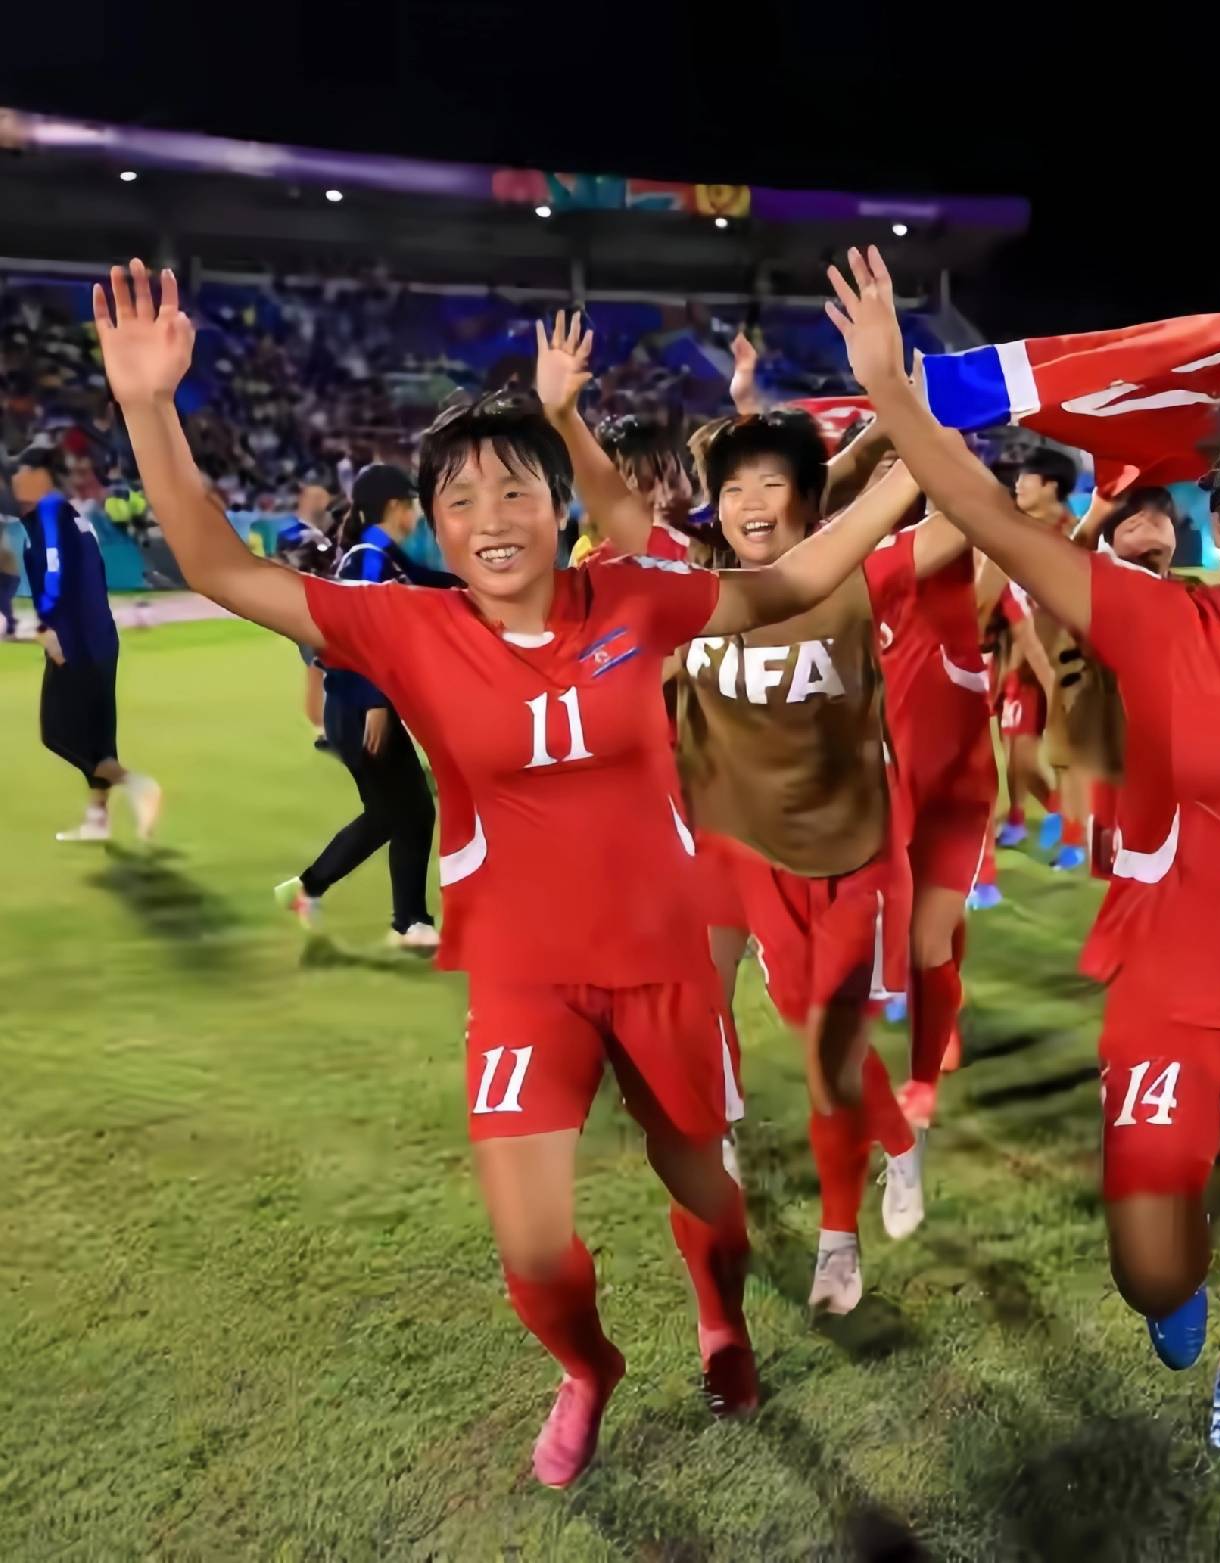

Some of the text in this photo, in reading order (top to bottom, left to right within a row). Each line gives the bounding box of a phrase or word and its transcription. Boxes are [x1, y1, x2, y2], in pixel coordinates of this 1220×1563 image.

[685, 636, 846, 705] FIFA
[524, 685, 594, 769] 11
[472, 1044, 534, 1115] 11
[1113, 1060, 1182, 1127] 14
